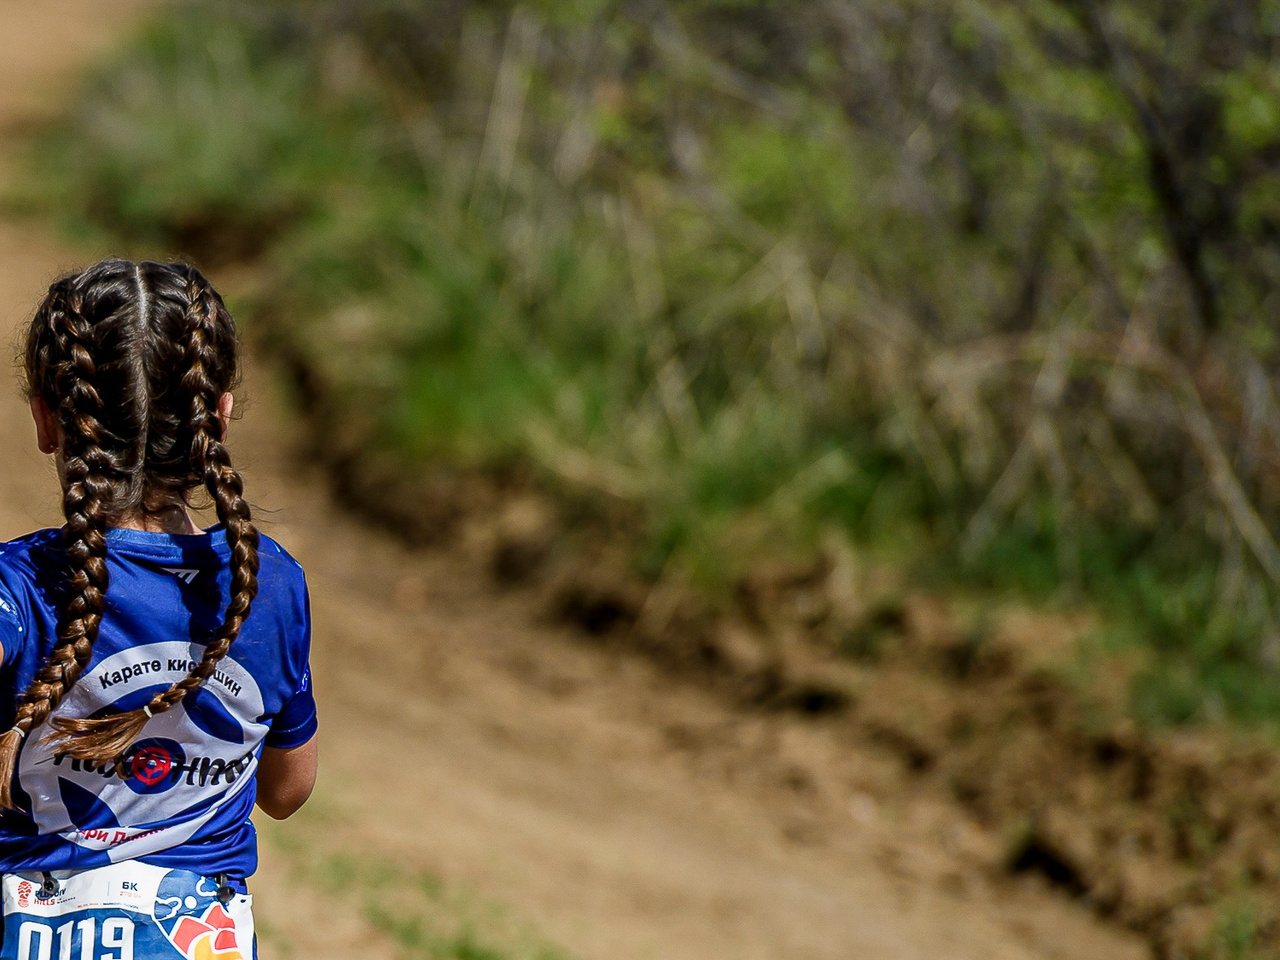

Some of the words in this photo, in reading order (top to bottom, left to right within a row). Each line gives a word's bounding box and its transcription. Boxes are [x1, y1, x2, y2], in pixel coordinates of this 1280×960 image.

[98, 660, 162, 690] Карате
[167, 659, 242, 697] киошин
[122, 881, 138, 891] 6K
